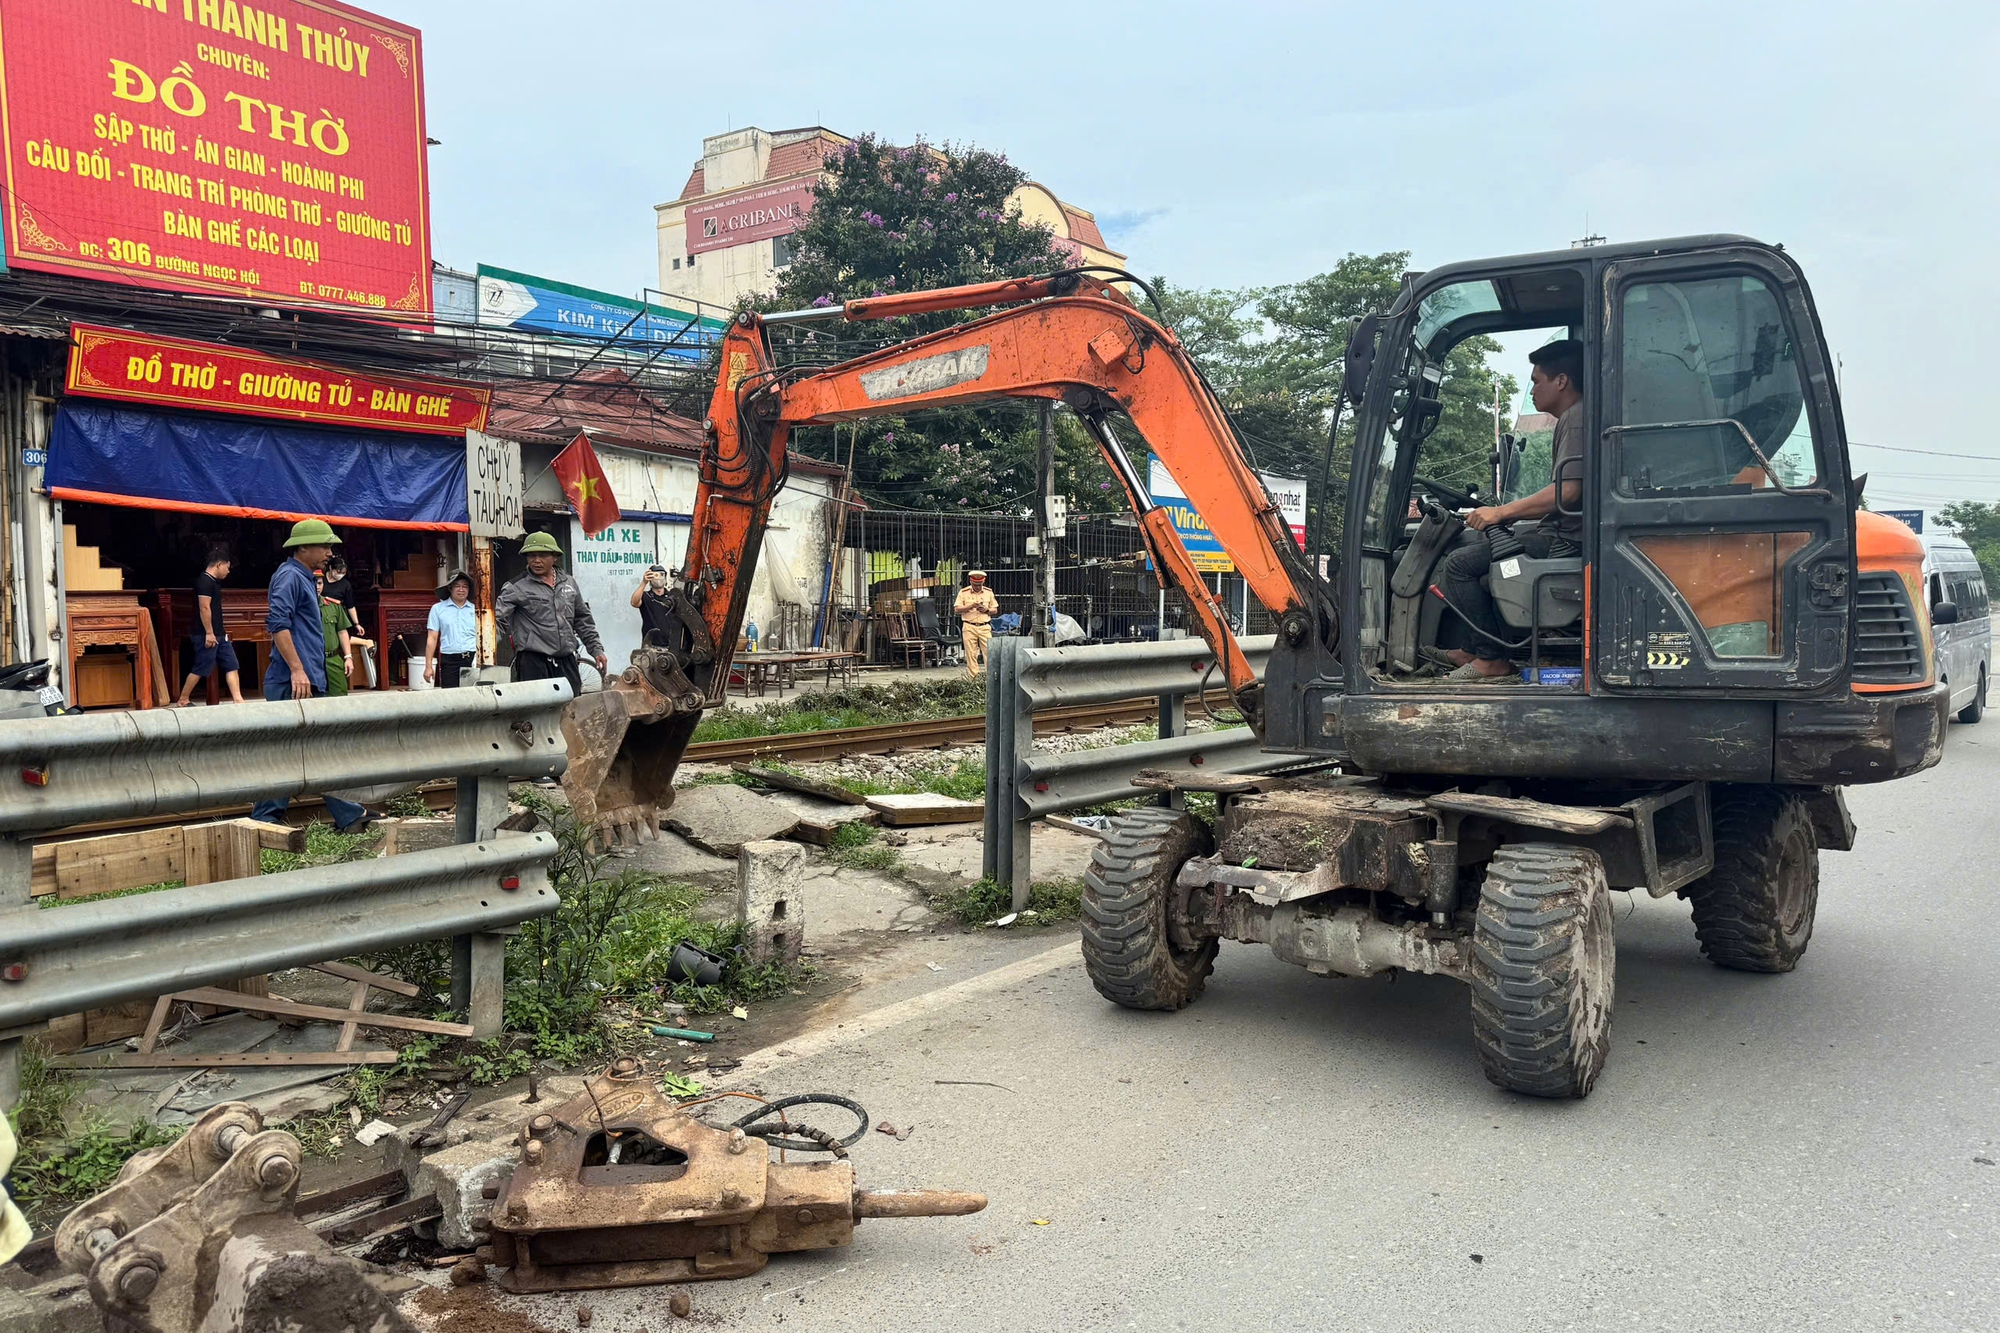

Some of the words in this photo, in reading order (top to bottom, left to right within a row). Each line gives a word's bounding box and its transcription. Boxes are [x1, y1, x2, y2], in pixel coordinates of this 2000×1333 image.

[197, 42, 270, 80] CHUYÊN:
[297, 23, 370, 77] THỦY
[108, 58, 206, 117] ĐỒ
[224, 90, 350, 156] THỜ
[93, 112, 134, 147] SẬP
[139, 124, 176, 155] THỜ
[194, 134, 220, 166] ÁN
[224, 145, 266, 177] GIAN
[281, 159, 336, 195] HOÀNH
[339, 174, 365, 201] PHI
[26, 138, 70, 173] CÂU
[76, 147, 111, 182] ĐỐI
[130, 162, 193, 200] TRANG
[196, 177, 226, 207] TRÍ
[230, 185, 288, 220] PHÒNG
[291, 199, 322, 227] THỜ
[336, 210, 391, 243] GIƯỜNG
[394, 218, 412, 247] TỦ
[79, 241, 104, 259] ĐC:
[107, 237, 152, 267] 306
[155, 254, 200, 276] ĐƯỜNG
[203, 262, 237, 283] NGỌC
[163, 208, 202, 241] BÀN
[207, 217, 242, 248] GHẾ
[246, 225, 280, 256] CÁC
[283, 235, 320, 267] LOẠI
[299, 280, 316, 296] ĐT:
[318, 285, 386, 308] 0777.446.888
[557, 308, 595, 330] KIM
[127, 352, 163, 383] ĐỒ
[170, 361, 218, 390] THỜ
[238, 371, 322, 404] GIƯỜNG
[328, 378, 353, 407] TỦ
[370, 387, 412, 414] BÀN
[415, 392, 454, 418] GHẾ
[26, 451, 48, 464] 306
[477, 442, 501, 481] CHÚ
[473, 482, 496, 525] TÀU
[498, 483, 521, 527] HỎA
[576, 550, 598, 563] THAY
[621, 528, 641, 543] XE
